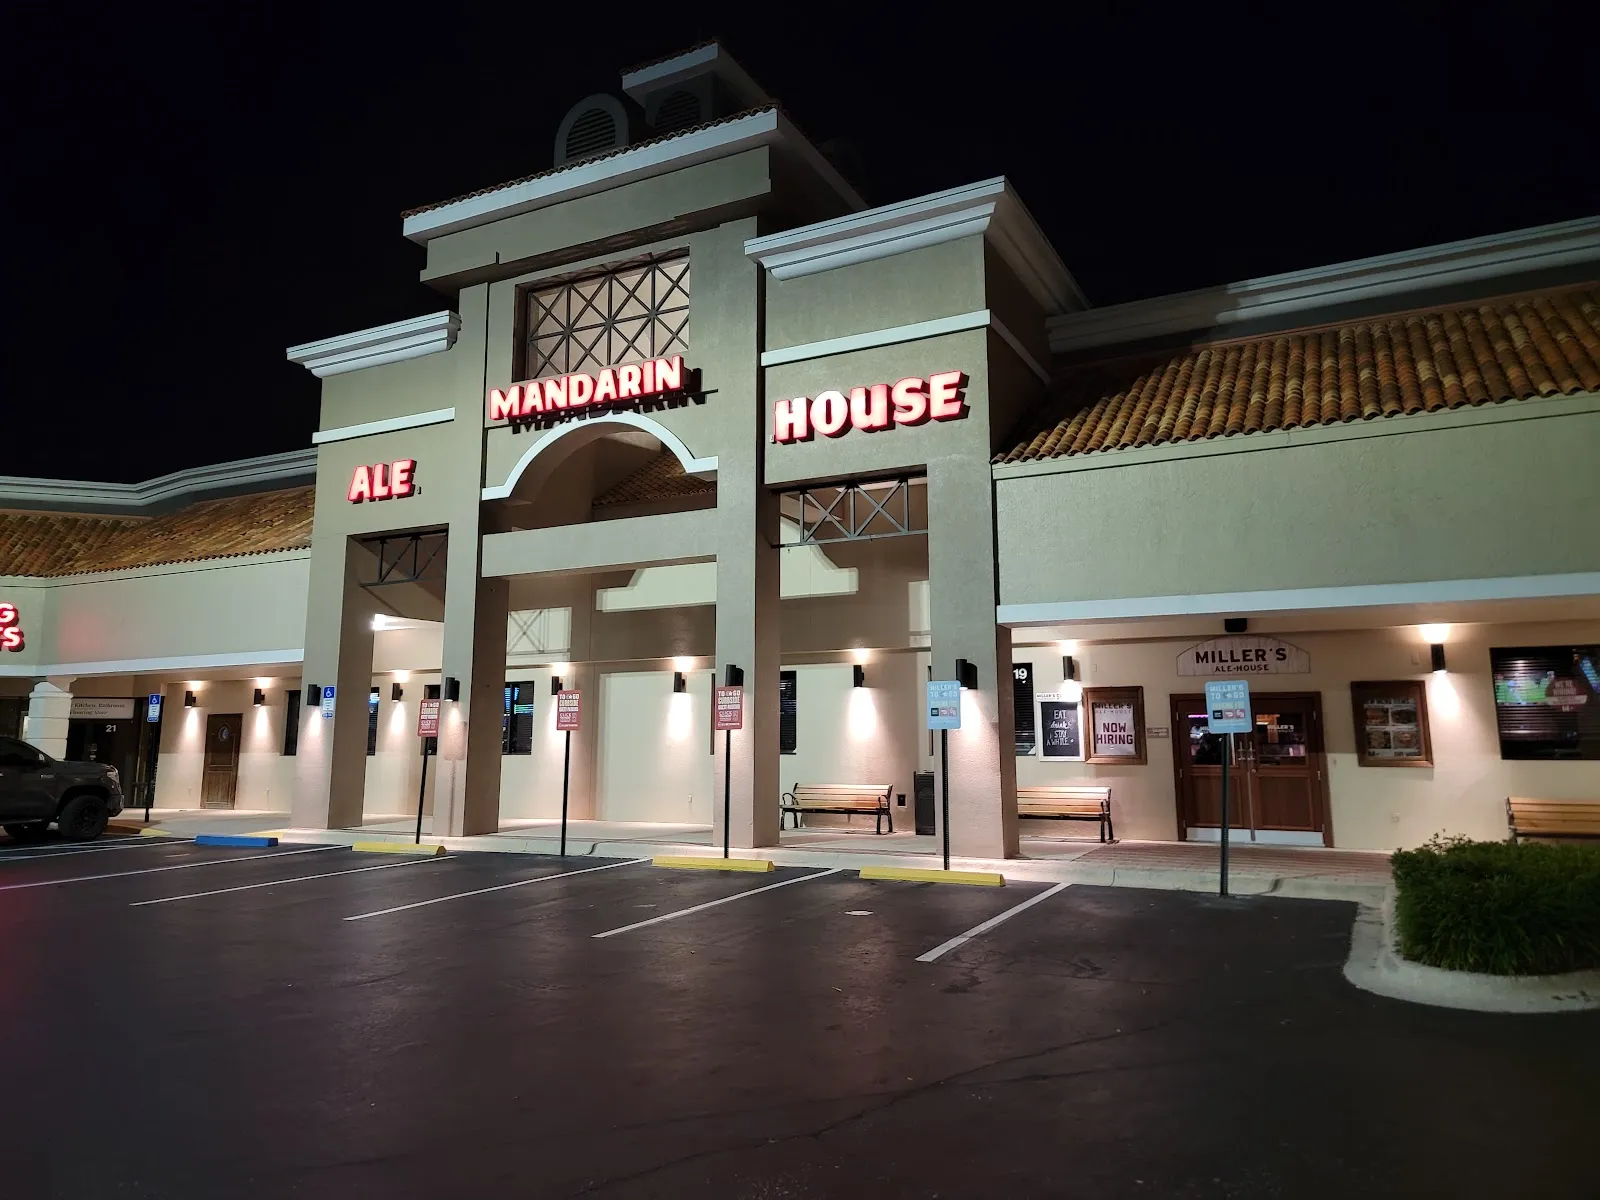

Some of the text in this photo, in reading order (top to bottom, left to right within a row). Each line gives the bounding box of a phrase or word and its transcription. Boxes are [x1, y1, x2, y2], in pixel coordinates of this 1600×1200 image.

[489, 355, 684, 421] MANDARIN
[774, 370, 969, 443] HOUSE
[348, 459, 416, 503] ALE
[1195, 648, 1287, 664] MILLER'S
[1013, 668, 1028, 680] 19
[1215, 664, 1270, 672] ALE-HOUSE
[1211, 692, 1221, 700] TO
[1053, 709, 1068, 720] EAT
[105, 724, 117, 733] 21
[1103, 722, 1127, 733] NOW
[1096, 733, 1134, 745] HIRING
